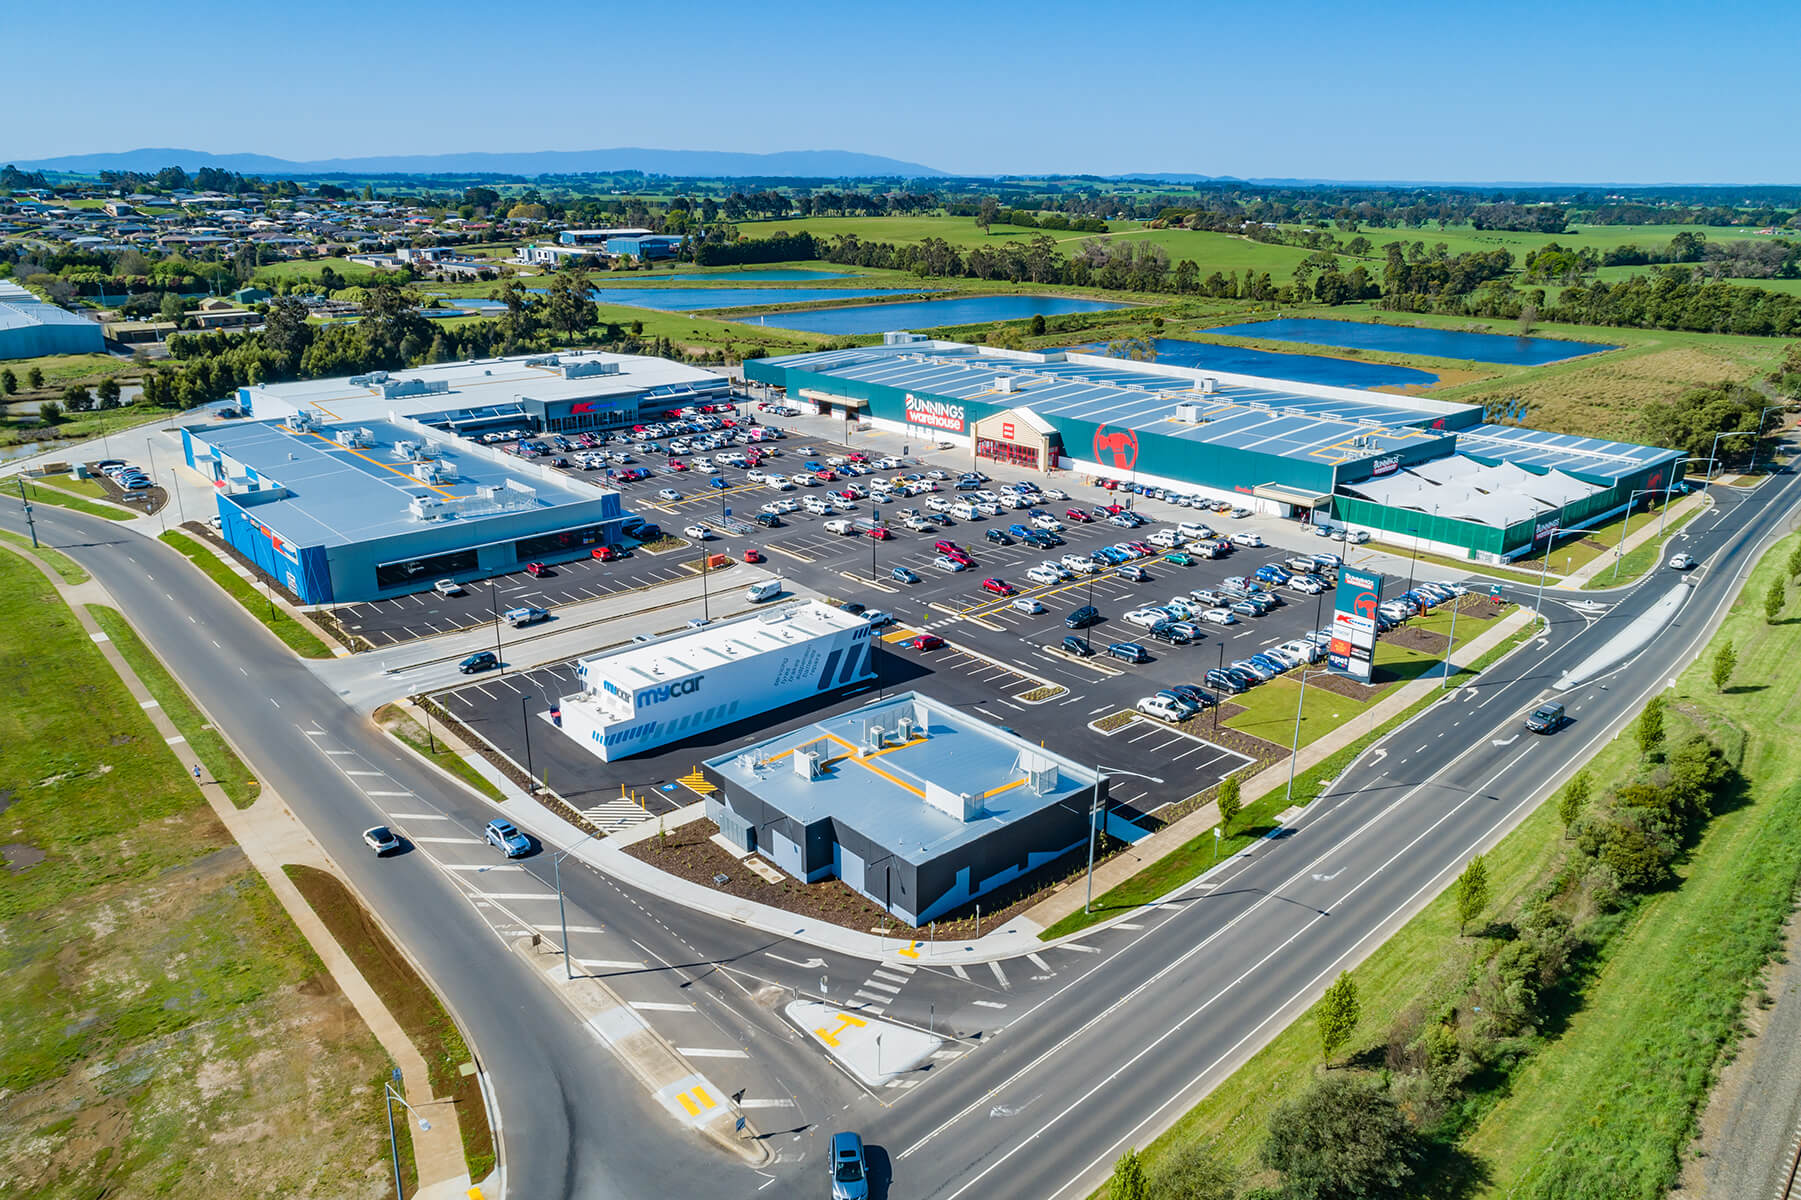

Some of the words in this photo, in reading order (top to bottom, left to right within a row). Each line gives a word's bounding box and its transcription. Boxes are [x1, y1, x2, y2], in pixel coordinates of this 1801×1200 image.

[906, 393, 965, 420] BUNNINGS
[909, 411, 961, 430] warehouse
[603, 680, 631, 703] mycar
[637, 676, 705, 708] mycar
